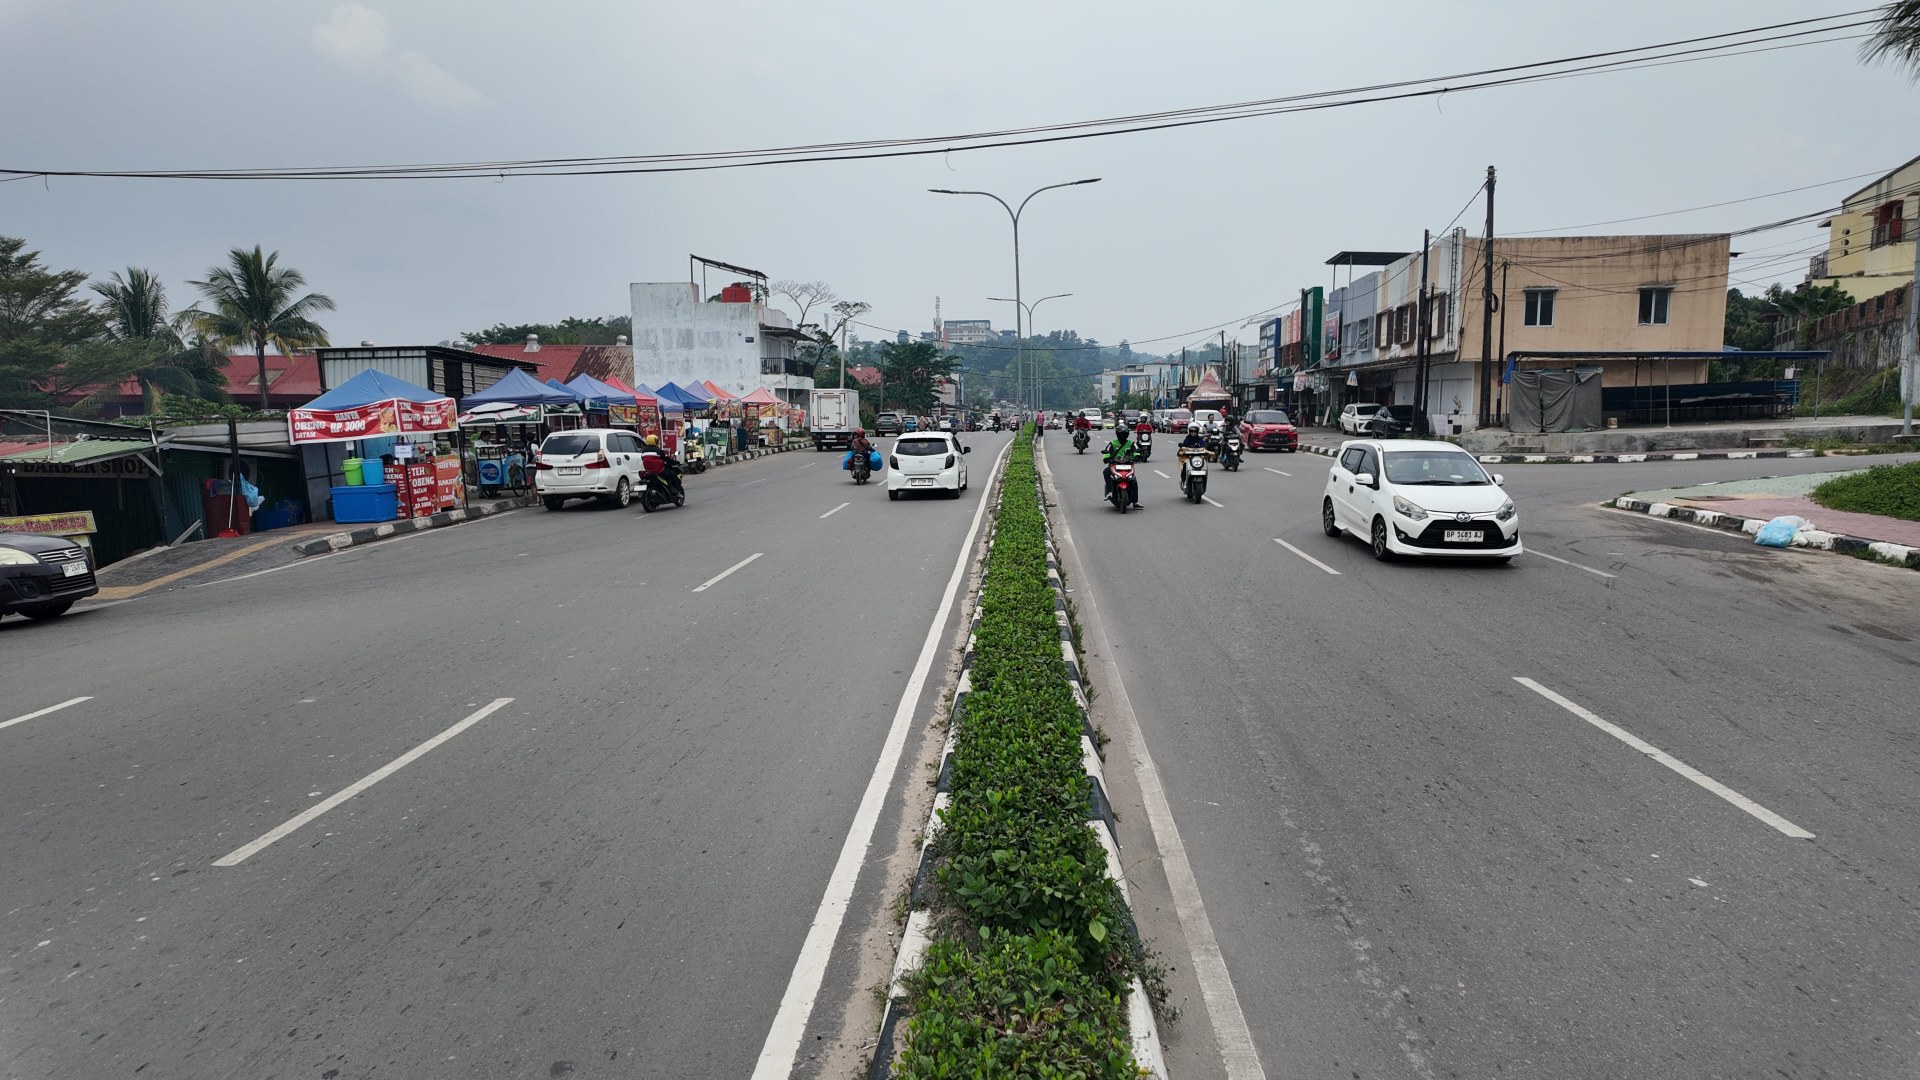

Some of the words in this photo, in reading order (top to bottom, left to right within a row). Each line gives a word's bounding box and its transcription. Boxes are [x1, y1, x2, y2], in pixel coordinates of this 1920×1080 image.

[294, 420, 326, 430] OBENG
[344, 420, 366, 432] 3000
[295, 431, 316, 439] BATAM
[411, 466, 425, 477] TEH
[412, 476, 434, 488] OBENG
